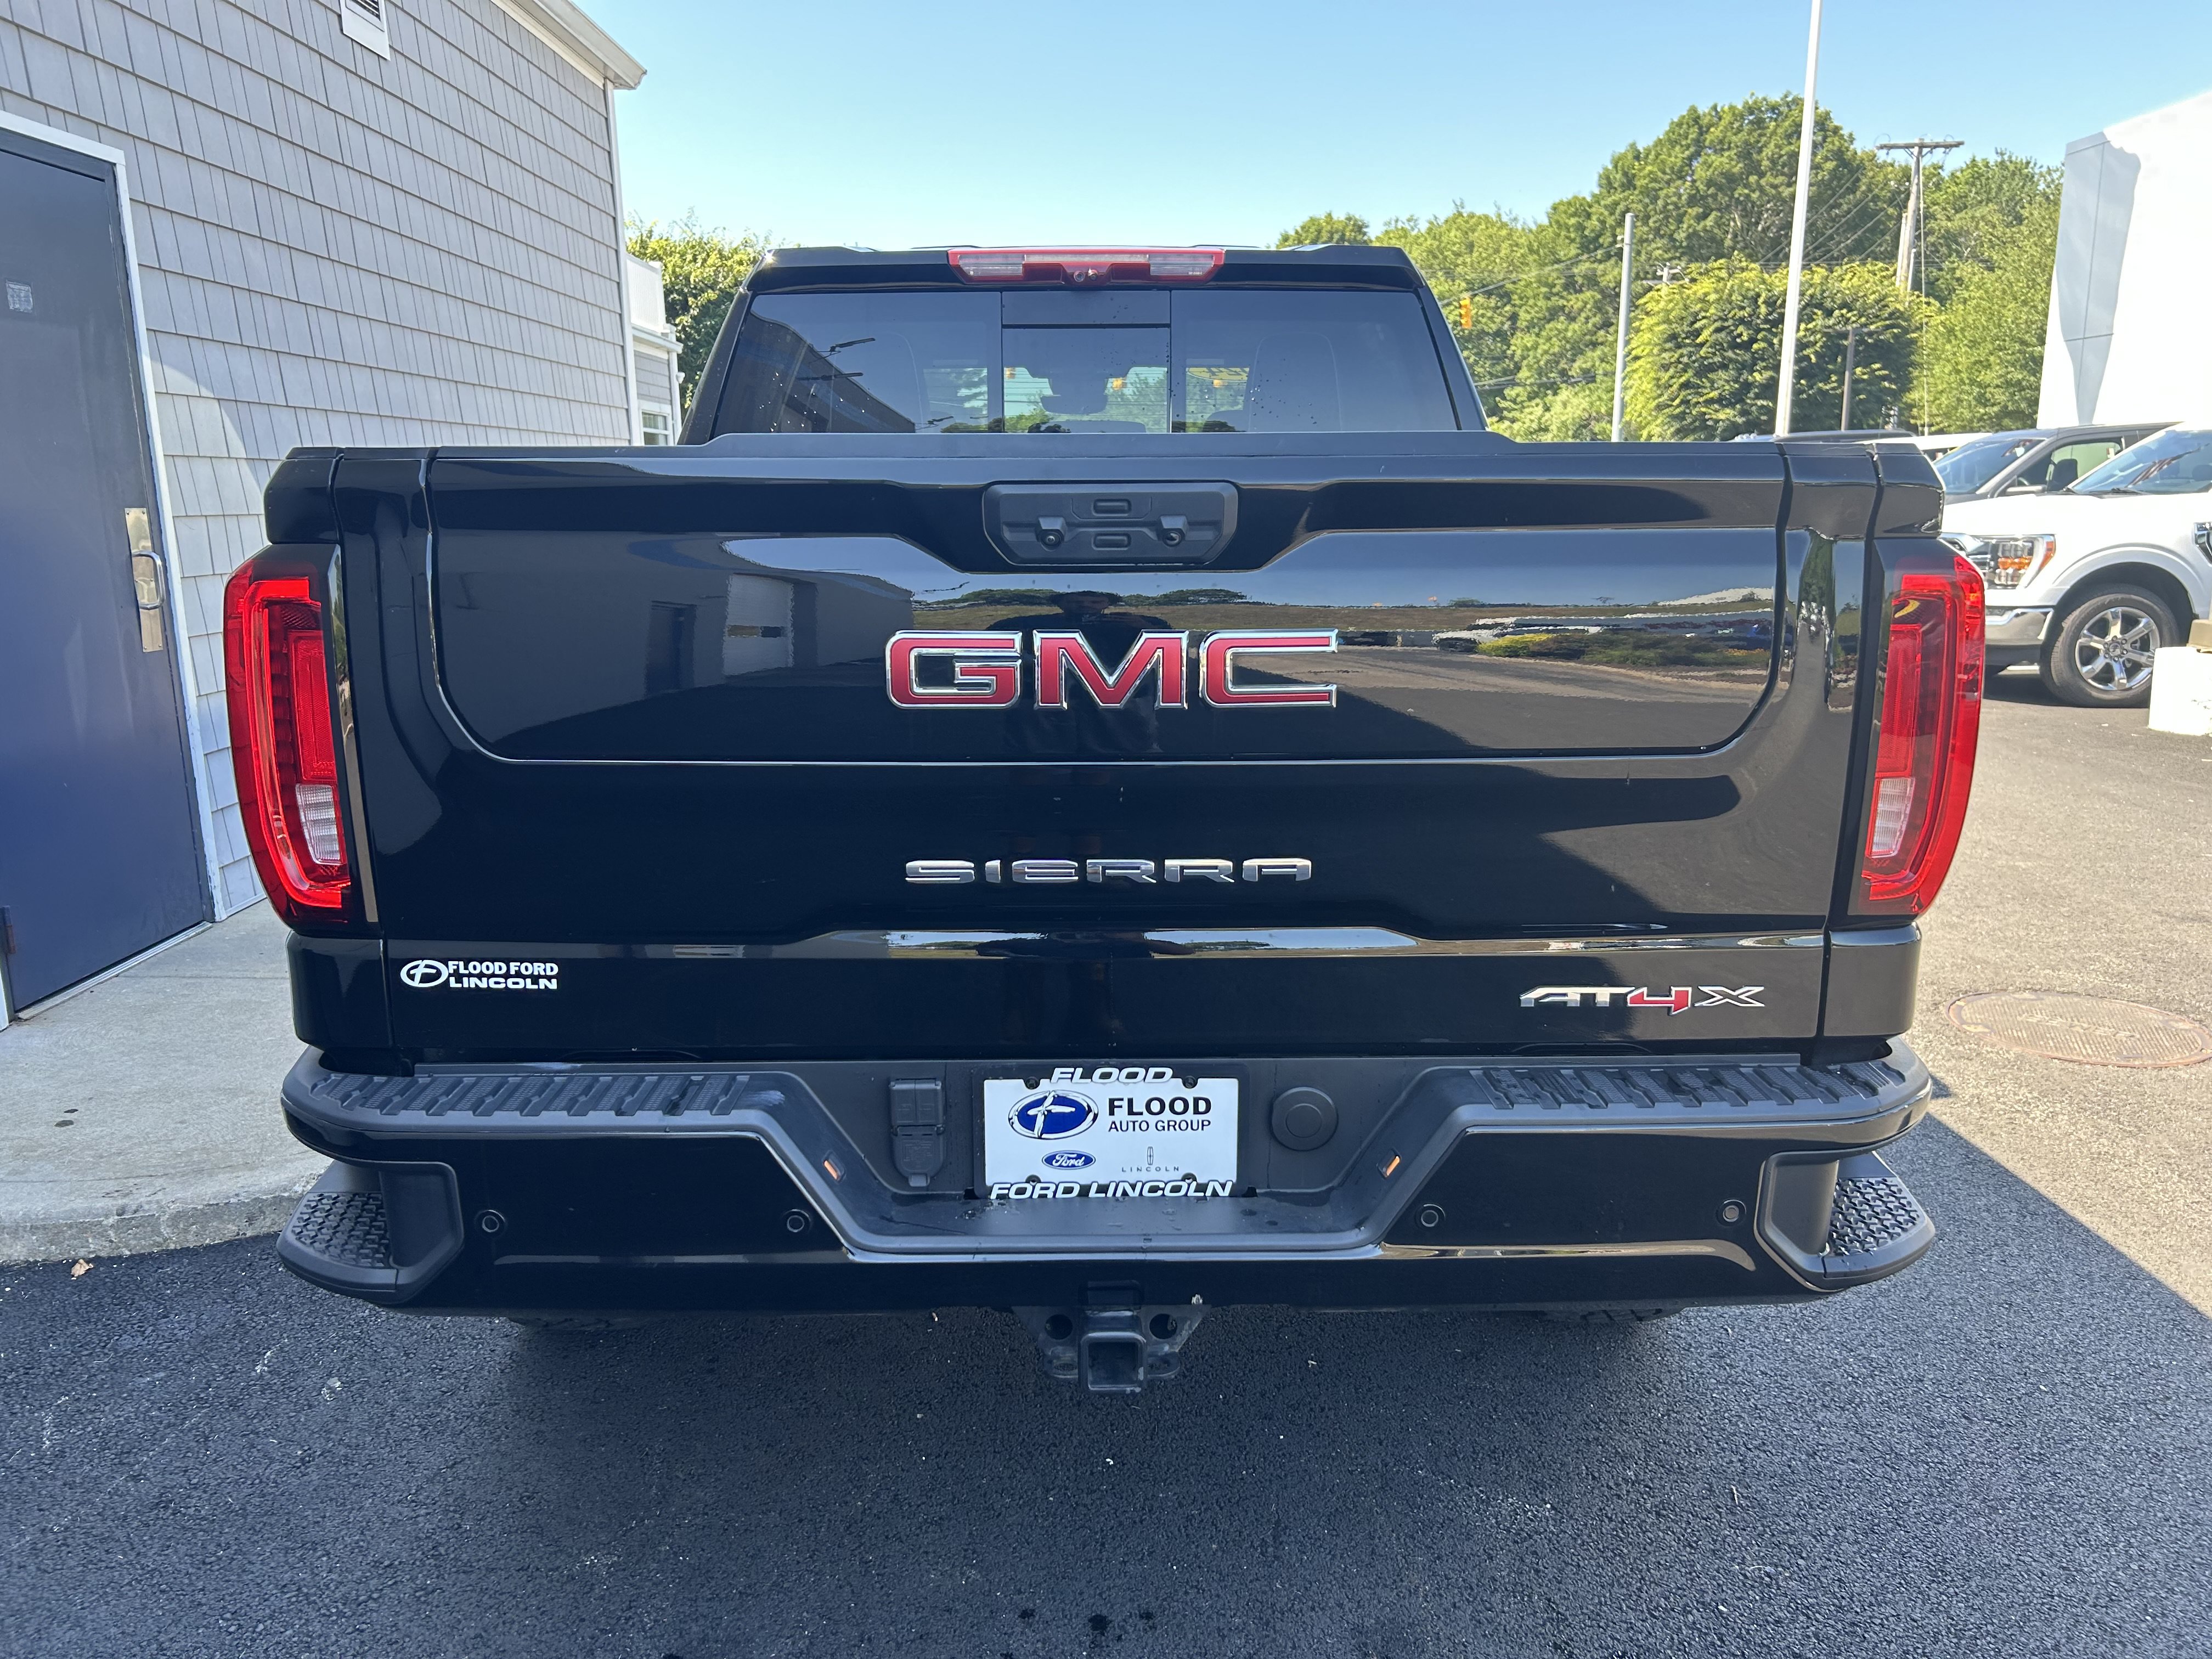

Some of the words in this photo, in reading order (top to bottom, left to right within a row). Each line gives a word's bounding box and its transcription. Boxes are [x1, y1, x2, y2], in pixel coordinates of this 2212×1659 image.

[886, 629, 1338, 710] GMC
[905, 858, 1312, 884] SIERRA
[448, 961, 506, 974] FLOOD
[509, 962, 558, 975] FORD
[449, 977, 557, 989] LINCOLN
[1520, 986, 1765, 1015] AT4X
[1051, 1067, 1173, 1084] FLOOD
[1108, 1097, 1211, 1116] FLOOD
[1108, 1120, 1149, 1132] AUTO
[1154, 1120, 1211, 1132] GROUP
[1052, 1153, 1085, 1167] Ford
[990, 1182, 1081, 1199] FORD
[1088, 1180, 1234, 1197] LINCOLN
